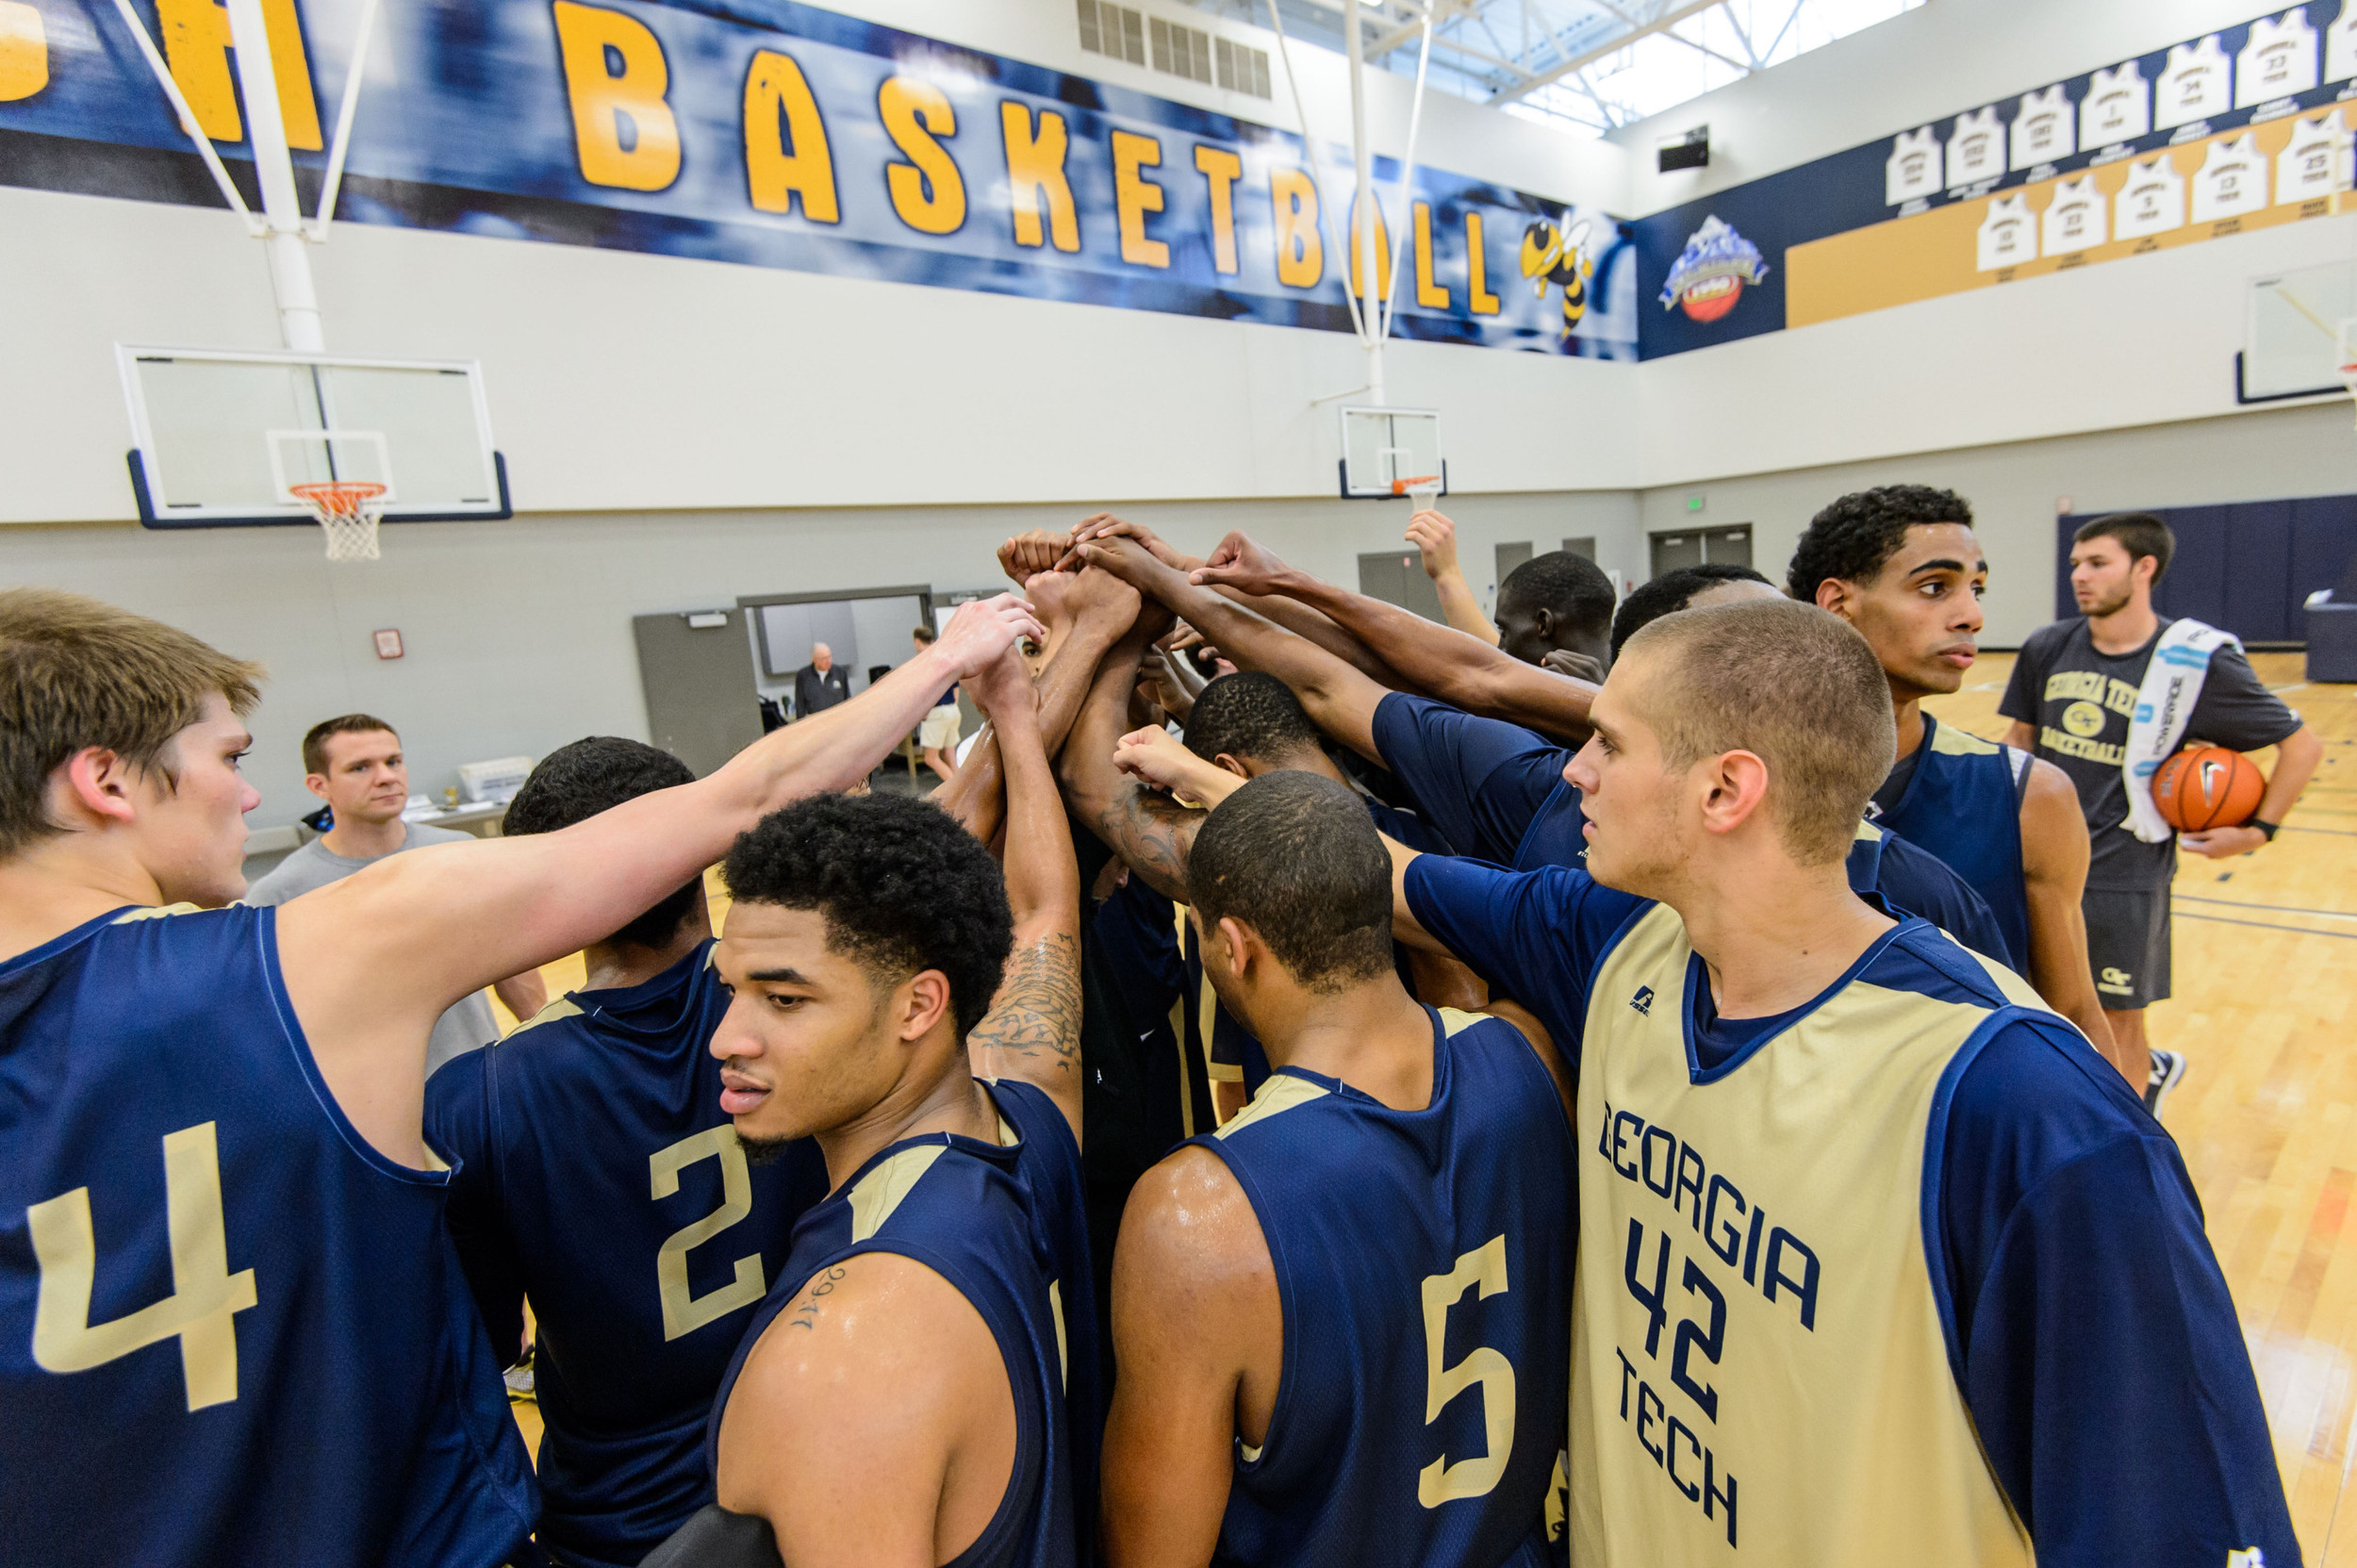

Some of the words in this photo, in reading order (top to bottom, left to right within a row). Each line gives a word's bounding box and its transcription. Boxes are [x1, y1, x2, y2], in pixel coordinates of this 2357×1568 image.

[553, 0, 1501, 316] BASKETBALL
[27, 1120, 258, 1413] 4
[650, 1123, 766, 1343] 2
[1598, 1099, 1821, 1333] GEORGIA
[1624, 1216, 1727, 1426] 42
[1418, 1233, 1516, 1509] 5
[1616, 1345, 1738, 1550] TECH
